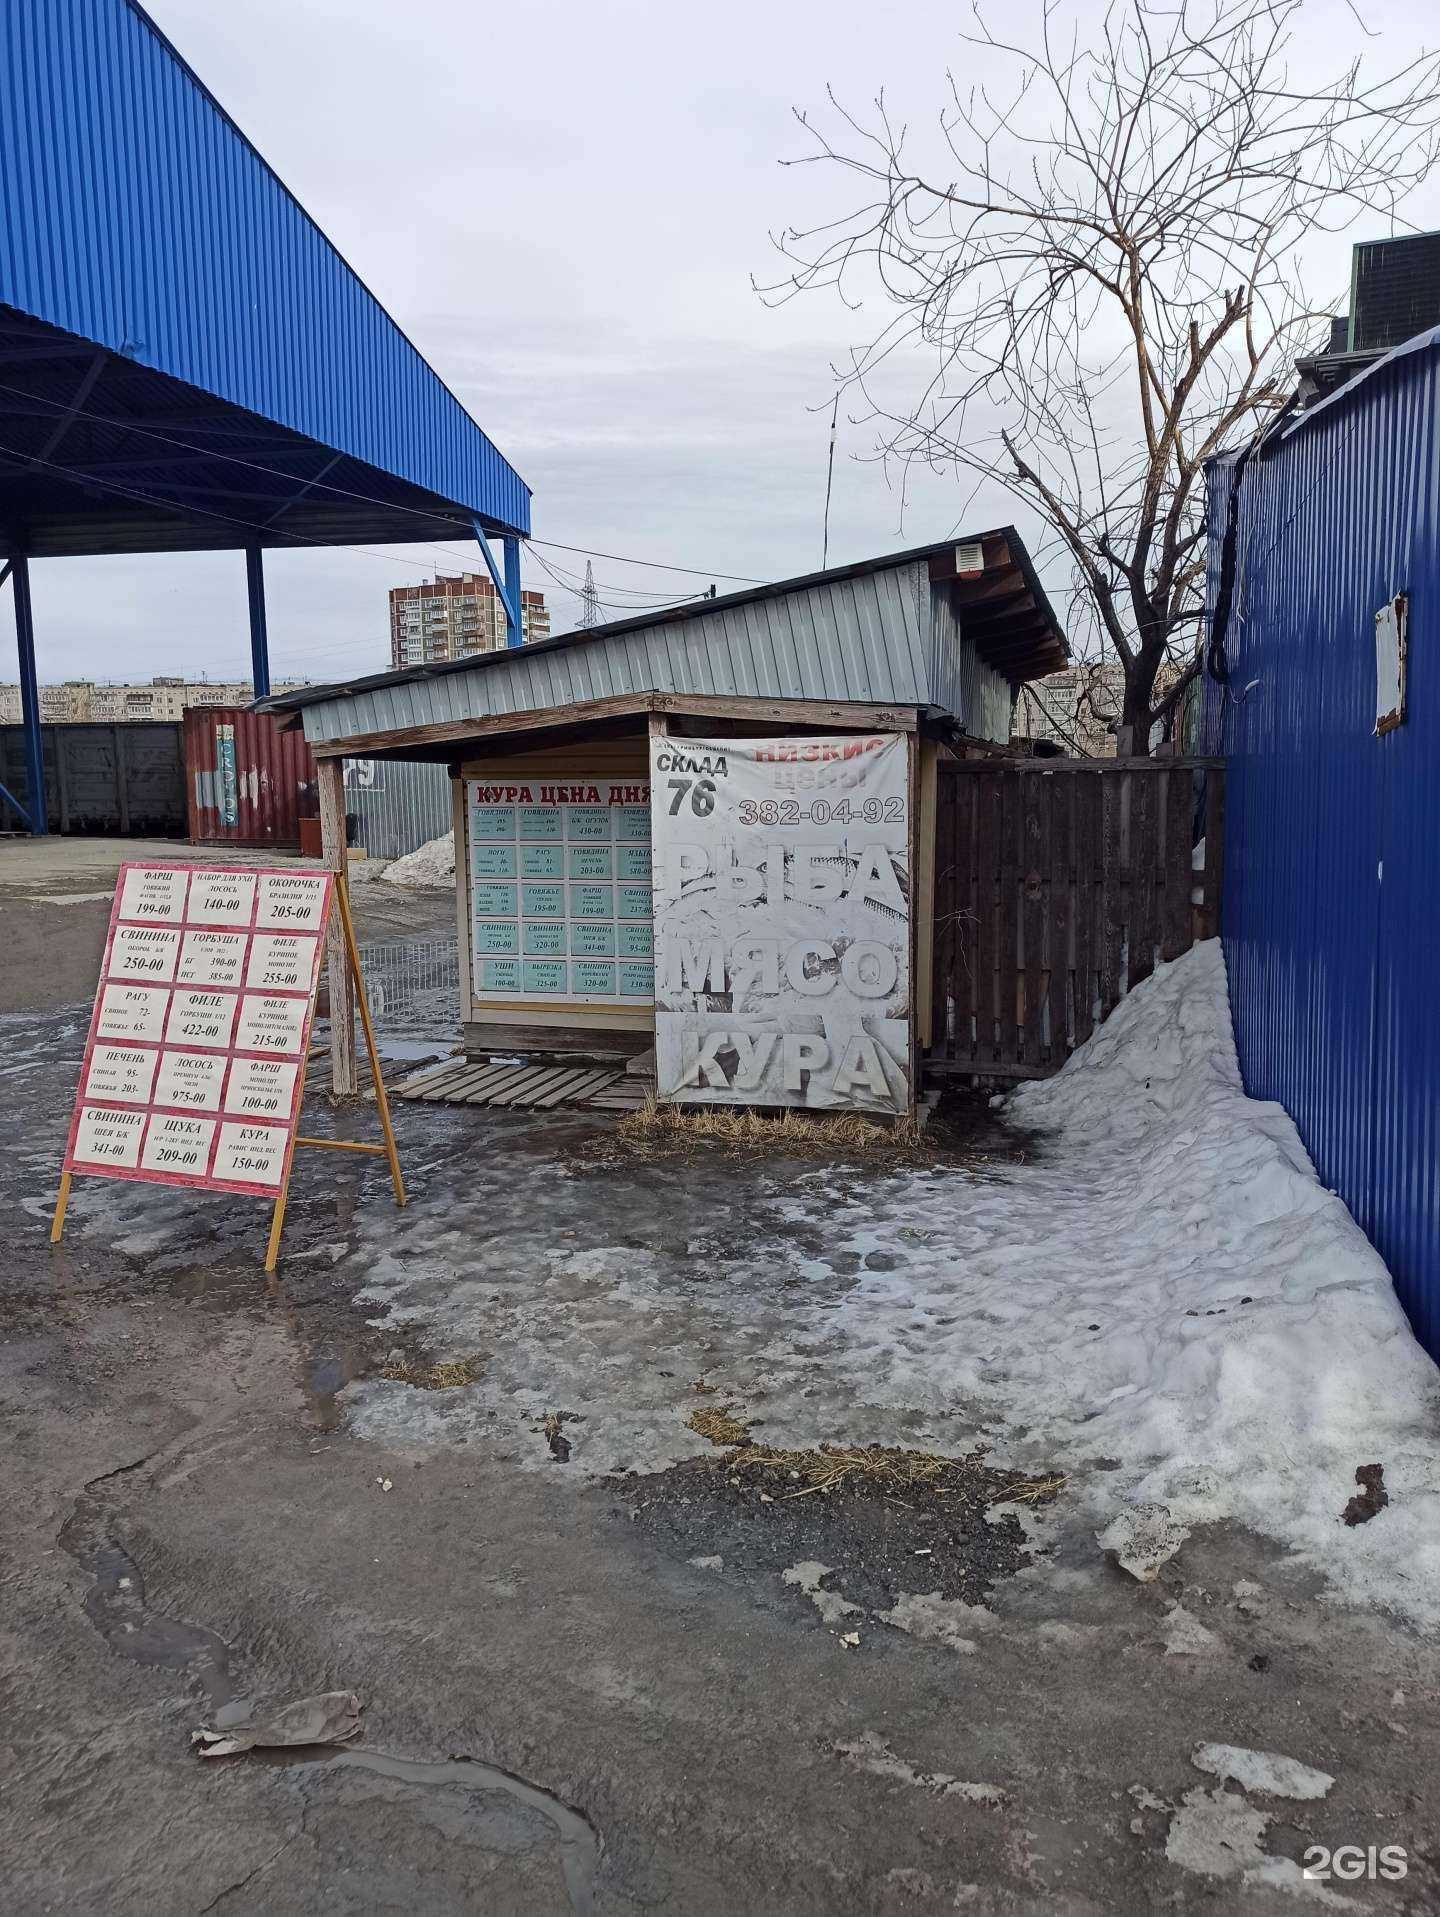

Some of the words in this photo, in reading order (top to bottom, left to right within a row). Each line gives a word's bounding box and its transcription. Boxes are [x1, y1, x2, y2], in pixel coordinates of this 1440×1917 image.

[477, 786, 534, 804] КУРА
[667, 779, 717, 818] 76
[739, 797, 905, 826] 382-04-92
[144, 872, 173, 881] ФАРШ
[268, 879, 321, 889] ОКОРОЧКА
[136, 902, 171, 915] 199-00
[203, 898, 240, 910] 140-00
[270, 905, 311, 919] 205-00
[120, 929, 176, 942] СВИНИНА
[193, 933, 240, 945] ГОРБУША
[273, 938, 298, 947] ФИЛЕ
[123, 956, 164, 971] 250-00
[210, 957, 238, 967] 390-00
[669, 938, 899, 998] МЯСО
[208, 972, 234, 981] 385-00
[262, 972, 298, 984] 255-00
[125, 991, 150, 1001] РАГУ
[189, 994, 224, 1007] ФИЛЕ
[263, 999, 289, 1009] ФИЛЕ
[182, 1023, 219, 1037] 422-00
[252, 1034, 288, 1047] 215-00
[106, 1051, 145, 1063] ПЕЧЕНЬ
[174, 1058, 214, 1070] ЛОСОСЬ
[250, 1062, 282, 1073] ФАРШ
[682, 1031, 893, 1097] КУРА
[172, 1090, 206, 1104] 975-00
[241, 1096, 278, 1110] 100-00
[87, 1110, 142, 1125] СВИНИНА
[94, 1128, 113, 1137] ШЕЯ
[164, 1119, 202, 1134] ЩУКА
[239, 1128, 270, 1141] КУРА
[91, 1142, 125, 1156] 341-00
[156, 1148, 198, 1165] 209-00
[232, 1157, 269, 1171] 150-00
